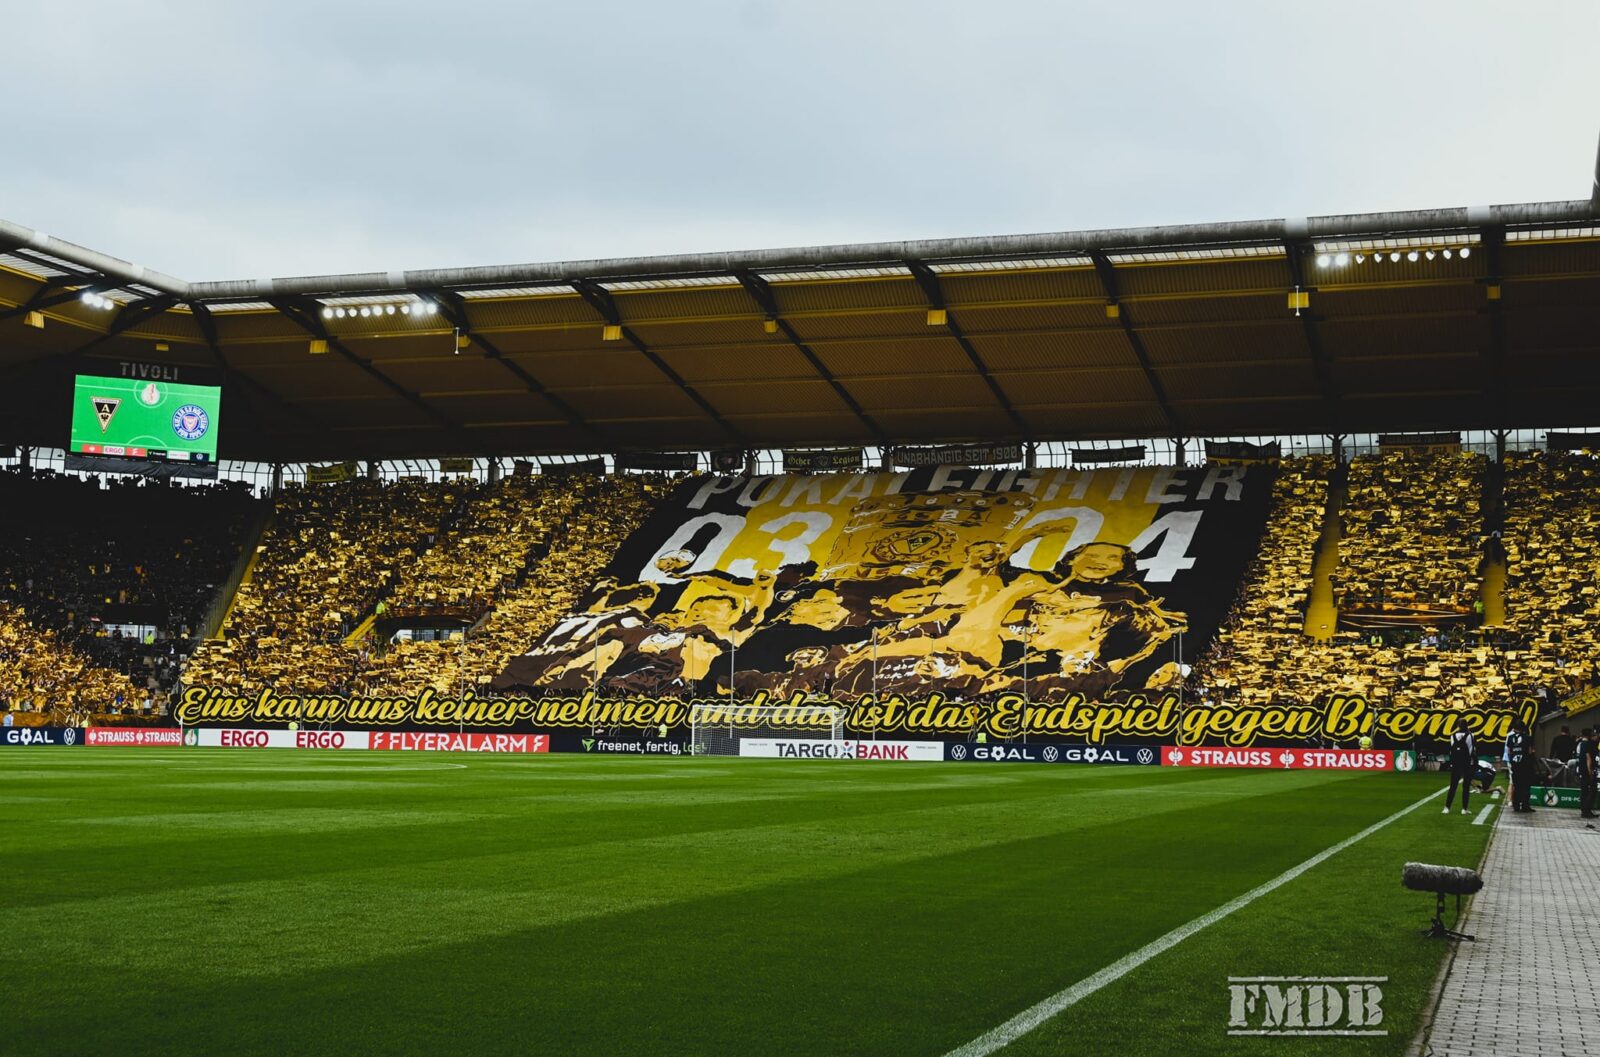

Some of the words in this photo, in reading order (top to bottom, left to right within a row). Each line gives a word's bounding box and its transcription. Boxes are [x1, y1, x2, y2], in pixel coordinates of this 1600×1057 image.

[119, 361, 179, 380] TIVOLI
[105, 447, 123, 455] ERGO
[896, 448, 961, 464] UNABHÄNGIG
[964, 447, 989, 462] SEIT
[991, 445, 1018, 460] 1900
[687, 466, 1247, 509] POKALFIGHTER
[638, 512, 833, 585] 03
[1008, 506, 1204, 582] 04
[178, 687, 249, 721] Eins
[255, 688, 344, 718] kann
[347, 699, 412, 720] uns
[415, 689, 535, 721] keiner
[535, 691, 684, 724] nehmen
[687, 692, 767, 724] und
[771, 693, 845, 725] das
[856, 696, 905, 728] ist
[908, 694, 988, 728] das
[991, 696, 1178, 743] Endspiel
[1181, 708, 1319, 744] gegen
[1325, 698, 1534, 738] Bremen!
[7, 728, 54, 745] GOAL
[98, 731, 135, 743] STRAUSS
[145, 732, 182, 743] STRAUSS
[221, 731, 269, 748] ERGO
[296, 732, 345, 749] ERGO
[390, 733, 526, 753] FLYERALARM
[597, 740, 645, 754] freenet,
[646, 741, 681, 755] fertig,
[974, 746, 1036, 761] GOAL
[1066, 748, 1129, 763] GOAL
[1191, 751, 1272, 766] STRAUSS
[1303, 753, 1385, 769] STRAUSS
